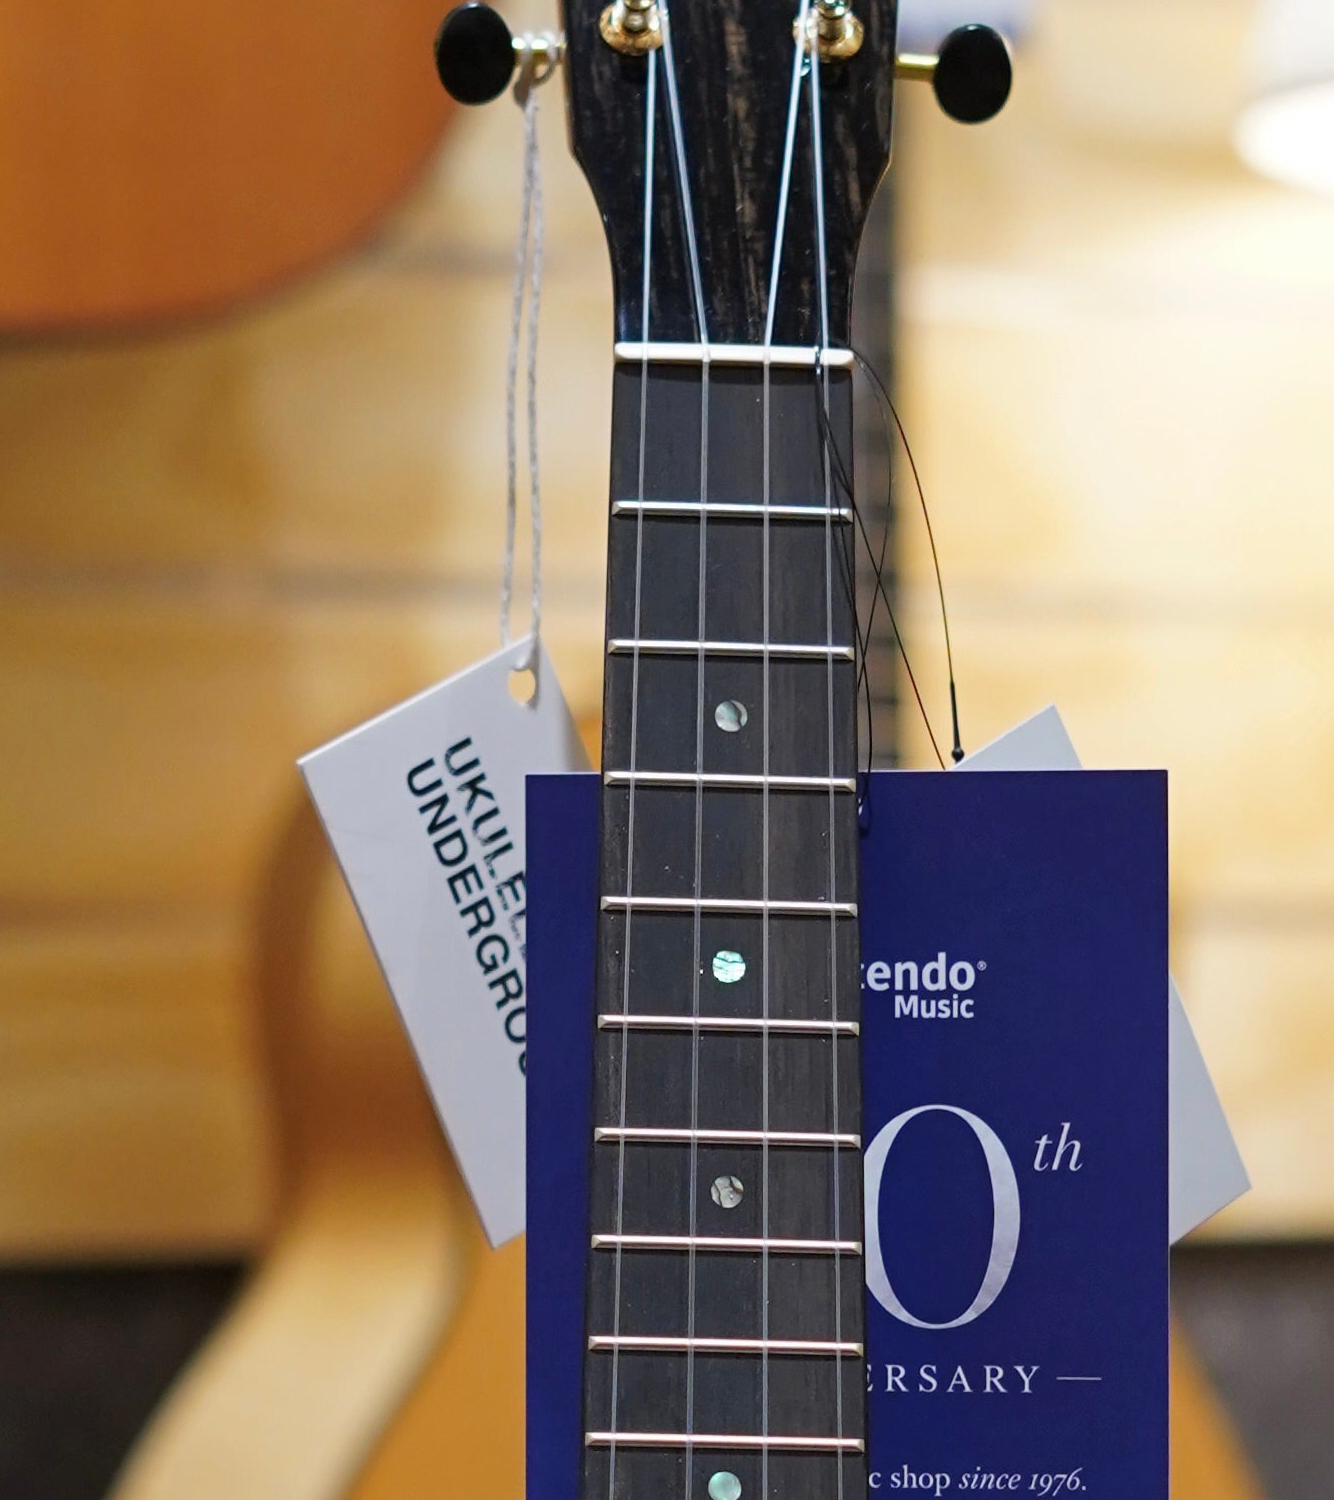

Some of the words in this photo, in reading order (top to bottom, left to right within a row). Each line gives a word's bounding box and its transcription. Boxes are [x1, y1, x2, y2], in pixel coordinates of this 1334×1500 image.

[407, 757, 526, 1077] UNDERGRO
[861, 952, 976, 992] endo
[894, 994, 975, 1019] Music
[890, 1464, 951, 1497] shop
[958, 1466, 1022, 1491] since
[1028, 1467, 1087, 1497] 1976.
